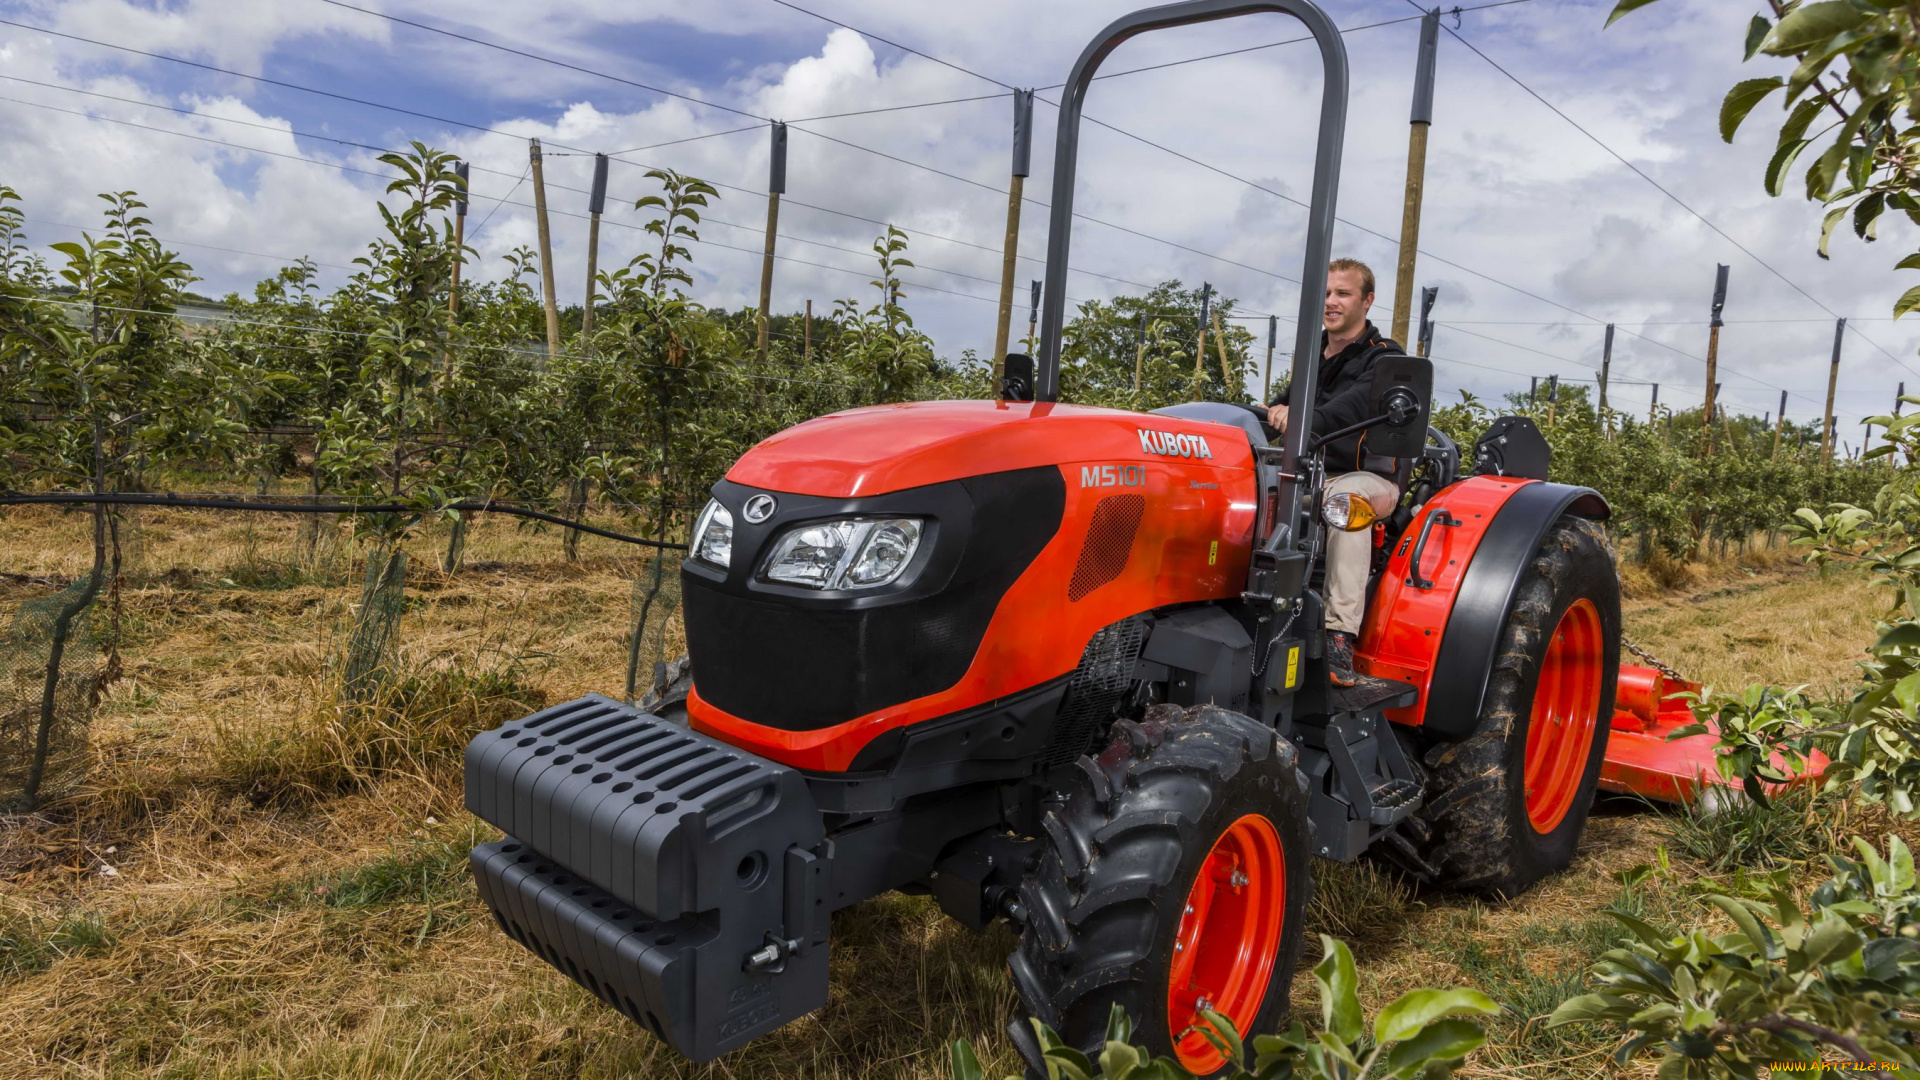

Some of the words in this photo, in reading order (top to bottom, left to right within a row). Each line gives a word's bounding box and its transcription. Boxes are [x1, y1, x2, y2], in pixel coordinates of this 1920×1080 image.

[1137, 428, 1214, 459] KUBOTA
[1081, 465, 1146, 488] M5101
[1231, 693, 1247, 709] HOT
[718, 1002, 777, 1040] KUBOTA
